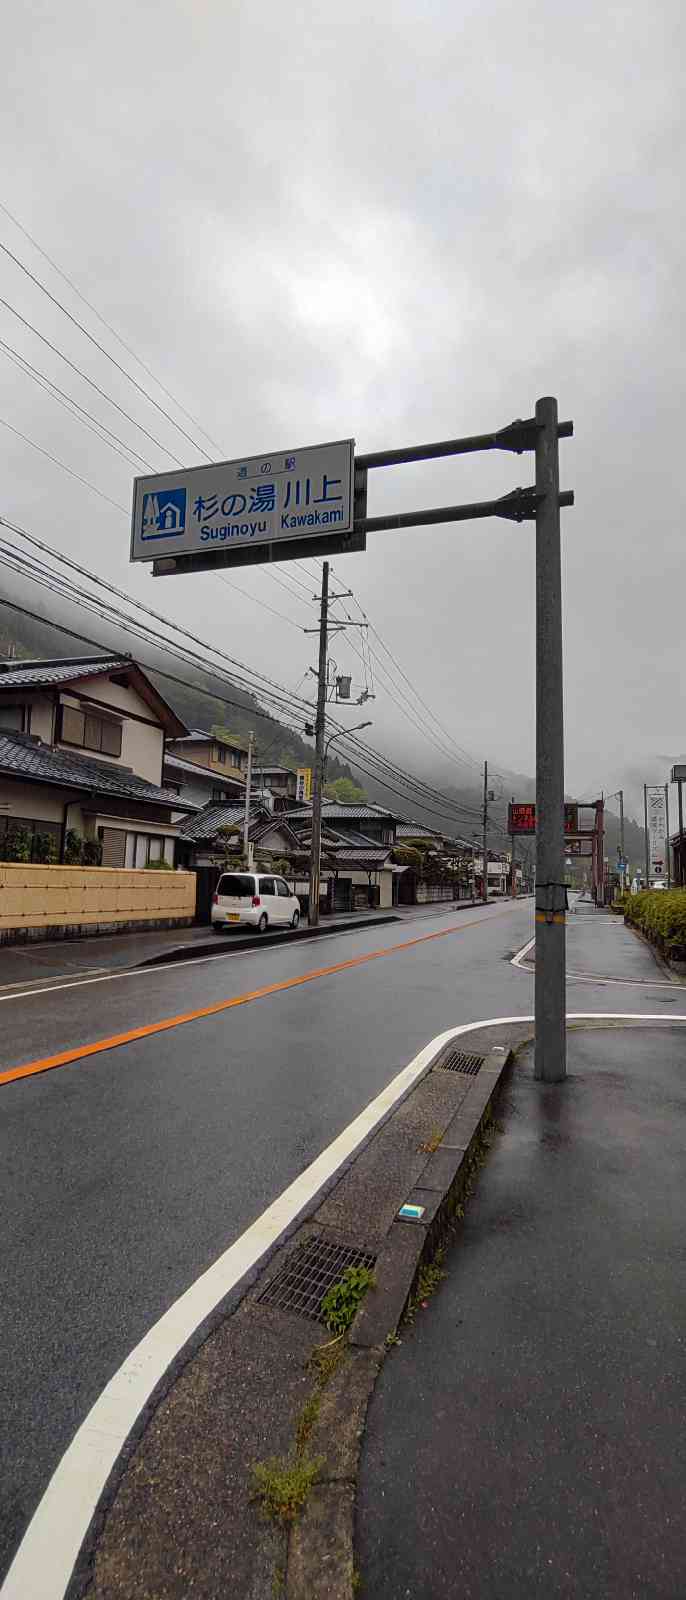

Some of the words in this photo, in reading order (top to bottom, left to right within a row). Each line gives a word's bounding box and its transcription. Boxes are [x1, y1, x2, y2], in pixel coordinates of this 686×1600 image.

[238, 457, 296, 479] 道の駅
[193, 484, 277, 522] 杉の湯
[283, 474, 343, 509] 川上
[200, 519, 267, 541] Suginoyu
[280, 505, 344, 529] Kawakami
